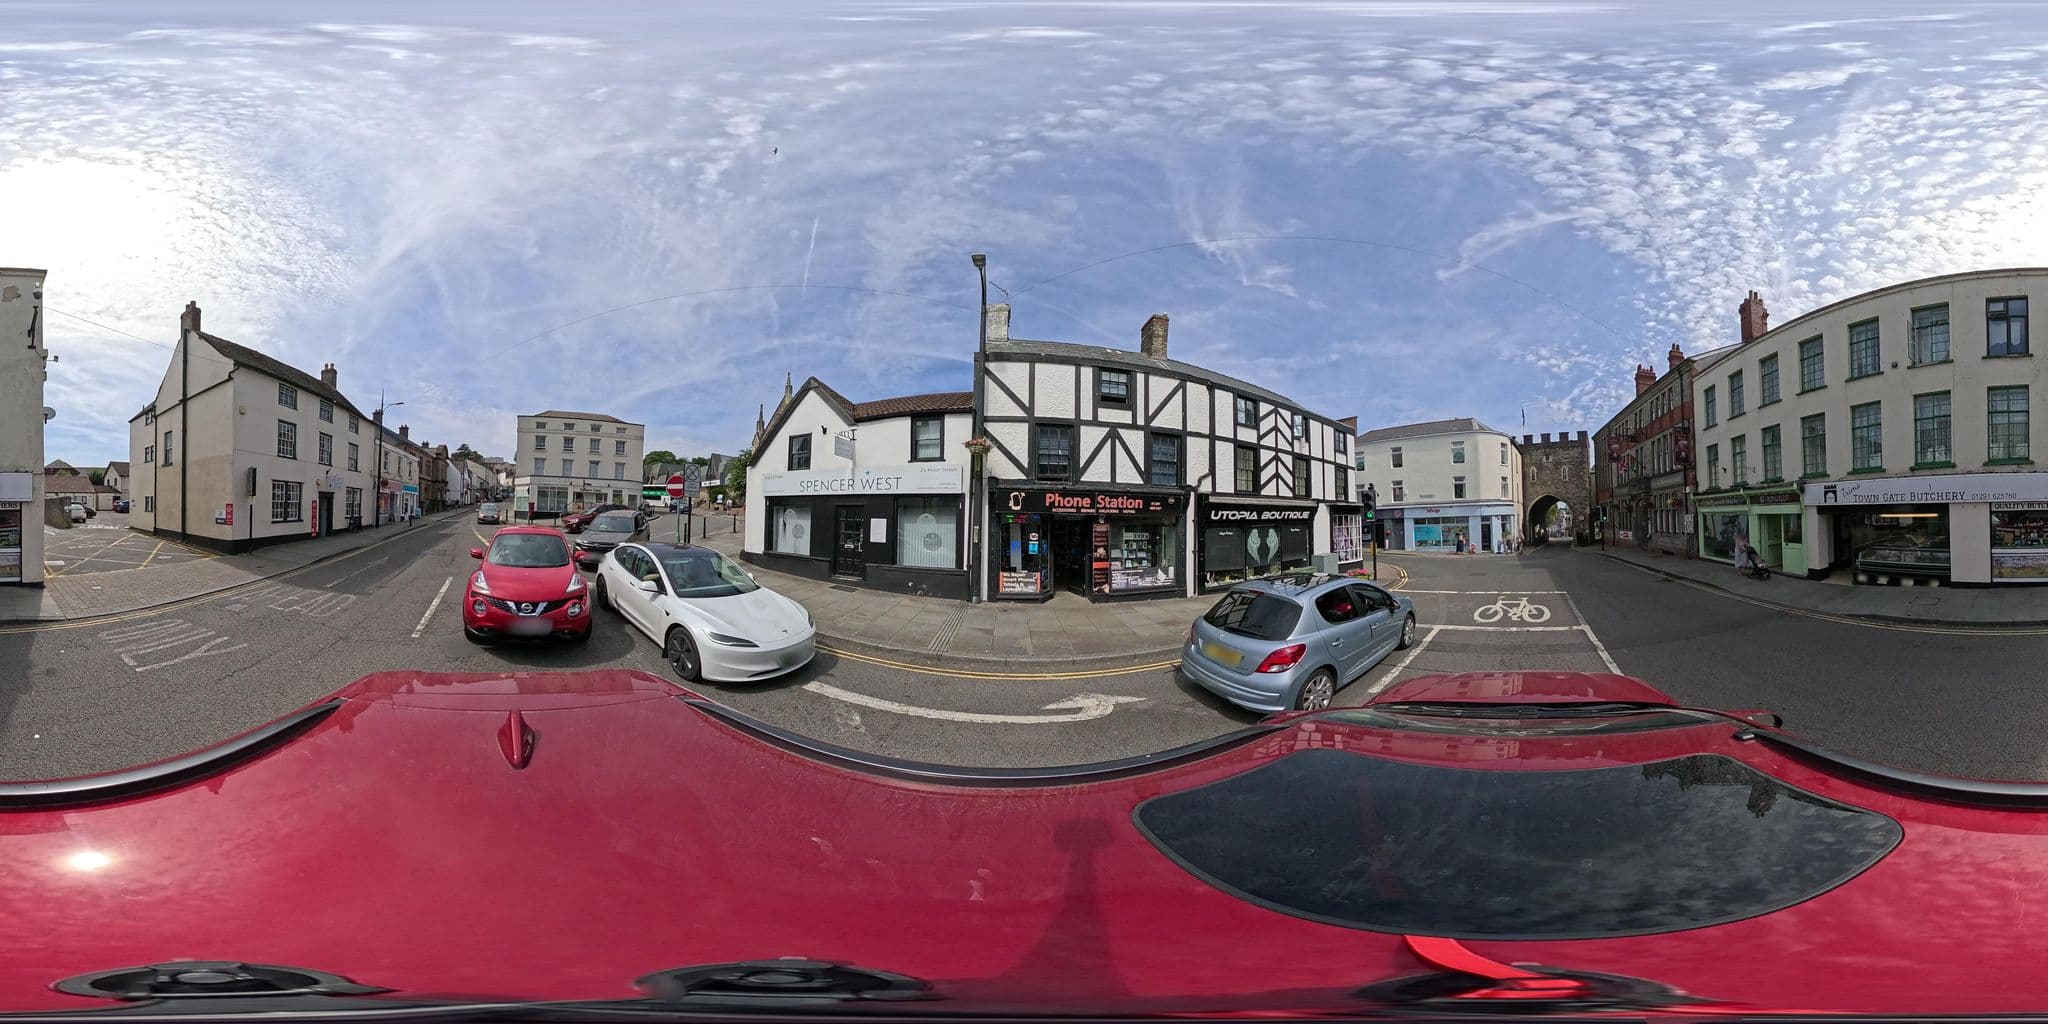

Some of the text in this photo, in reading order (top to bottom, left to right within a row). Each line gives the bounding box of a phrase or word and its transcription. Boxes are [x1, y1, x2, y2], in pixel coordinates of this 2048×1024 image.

[800, 476, 902, 492] SPENCER WEST
[1045, 493, 1091, 507] Phone
[1096, 494, 1143, 509] Station
[1853, 493, 1880, 503] TOWN
[1883, 492, 1906, 502] GATE
[1909, 491, 1966, 501] BUTCHERY
[1211, 511, 1310, 520] UTOPIA BOUTIQUE
[98, 618, 248, 672] ONLY
